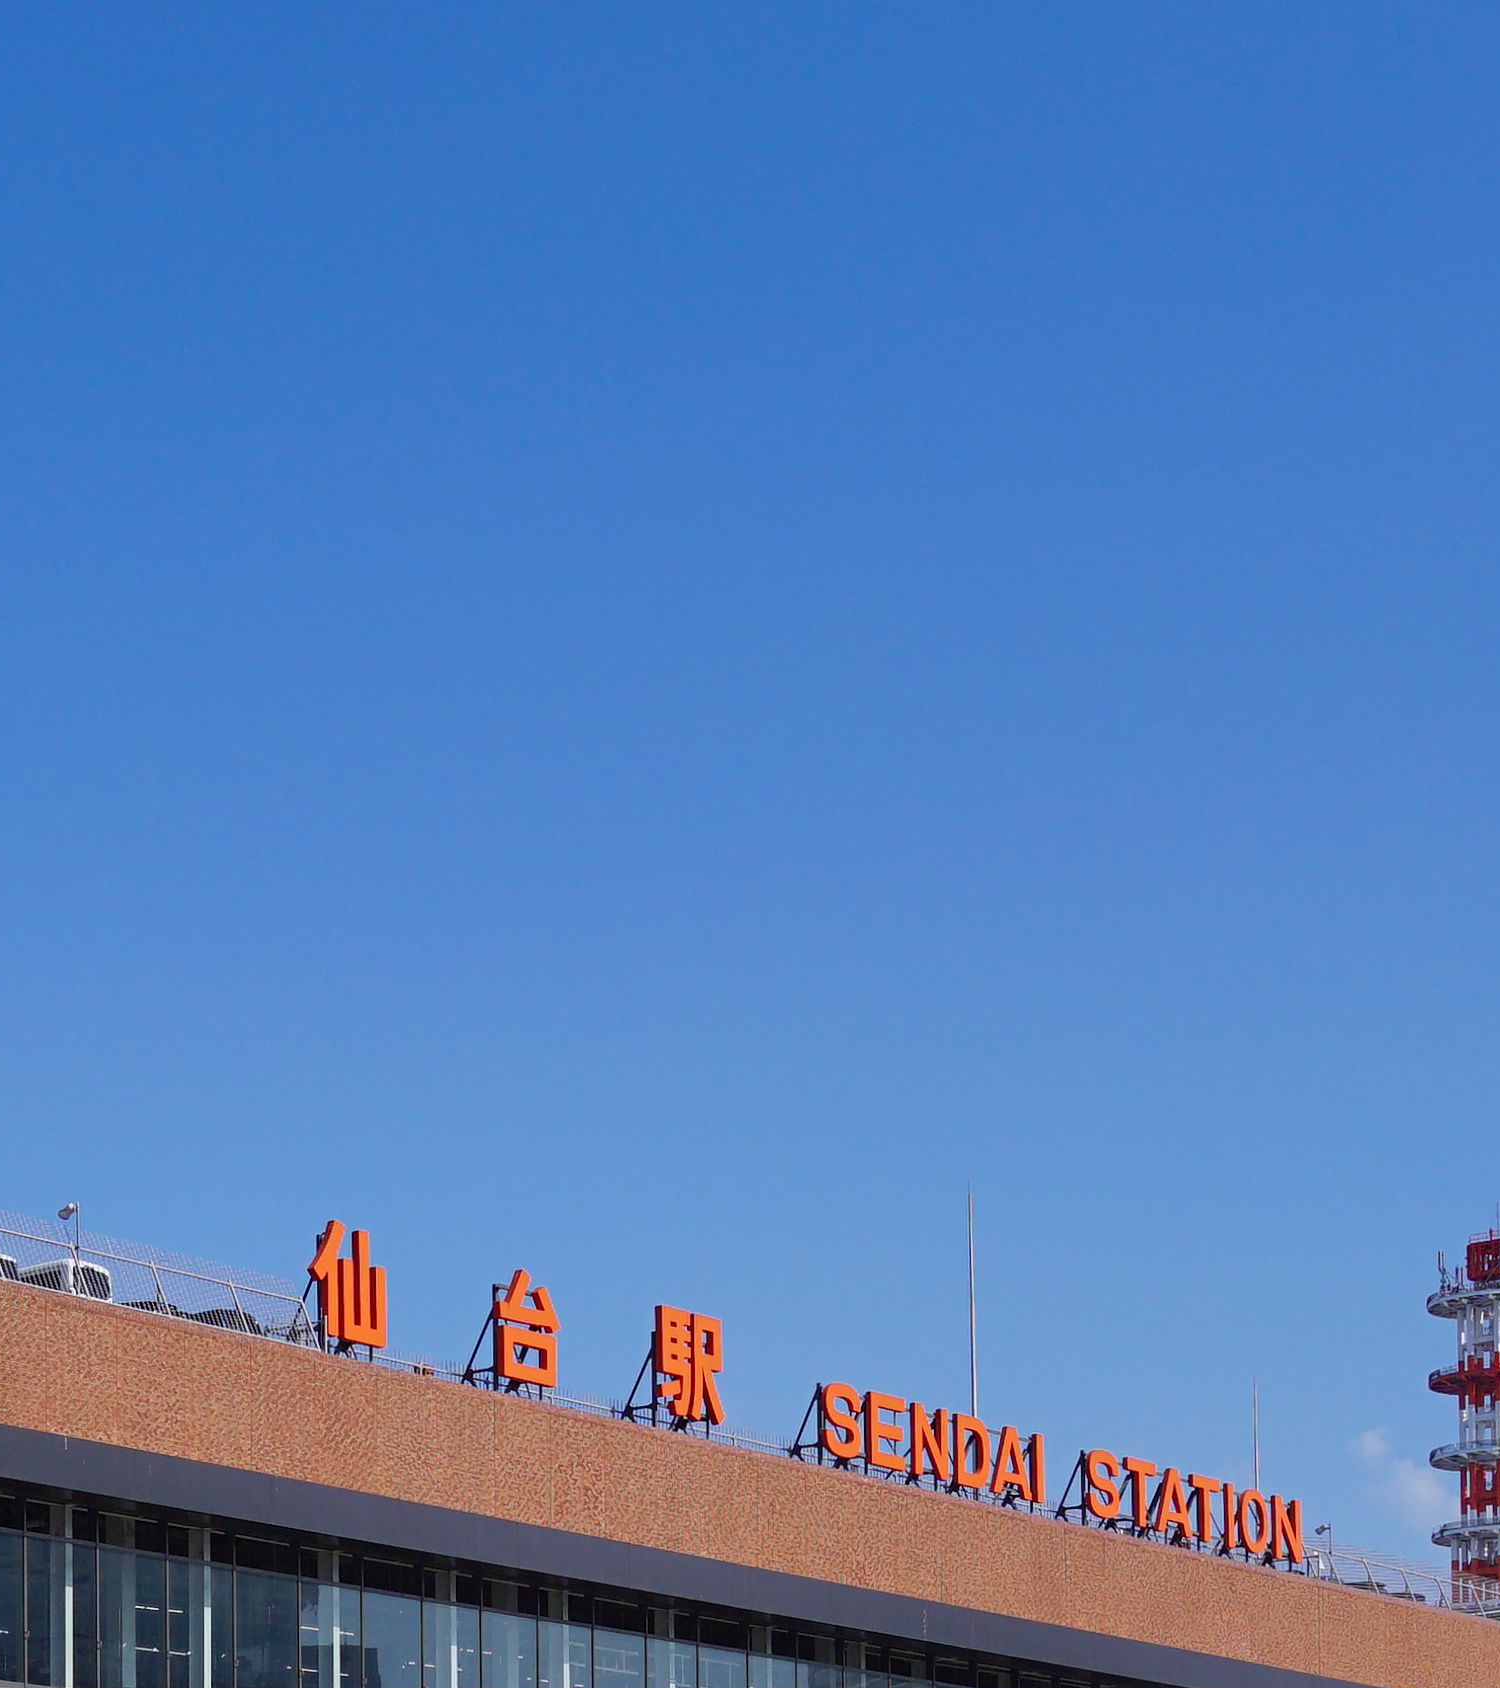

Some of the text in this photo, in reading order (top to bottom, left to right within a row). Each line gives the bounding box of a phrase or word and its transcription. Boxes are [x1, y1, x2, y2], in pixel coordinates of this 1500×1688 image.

[307, 1219, 724, 1426] 仙台駅
[819, 1381, 1305, 1564] SENDAI STATION
